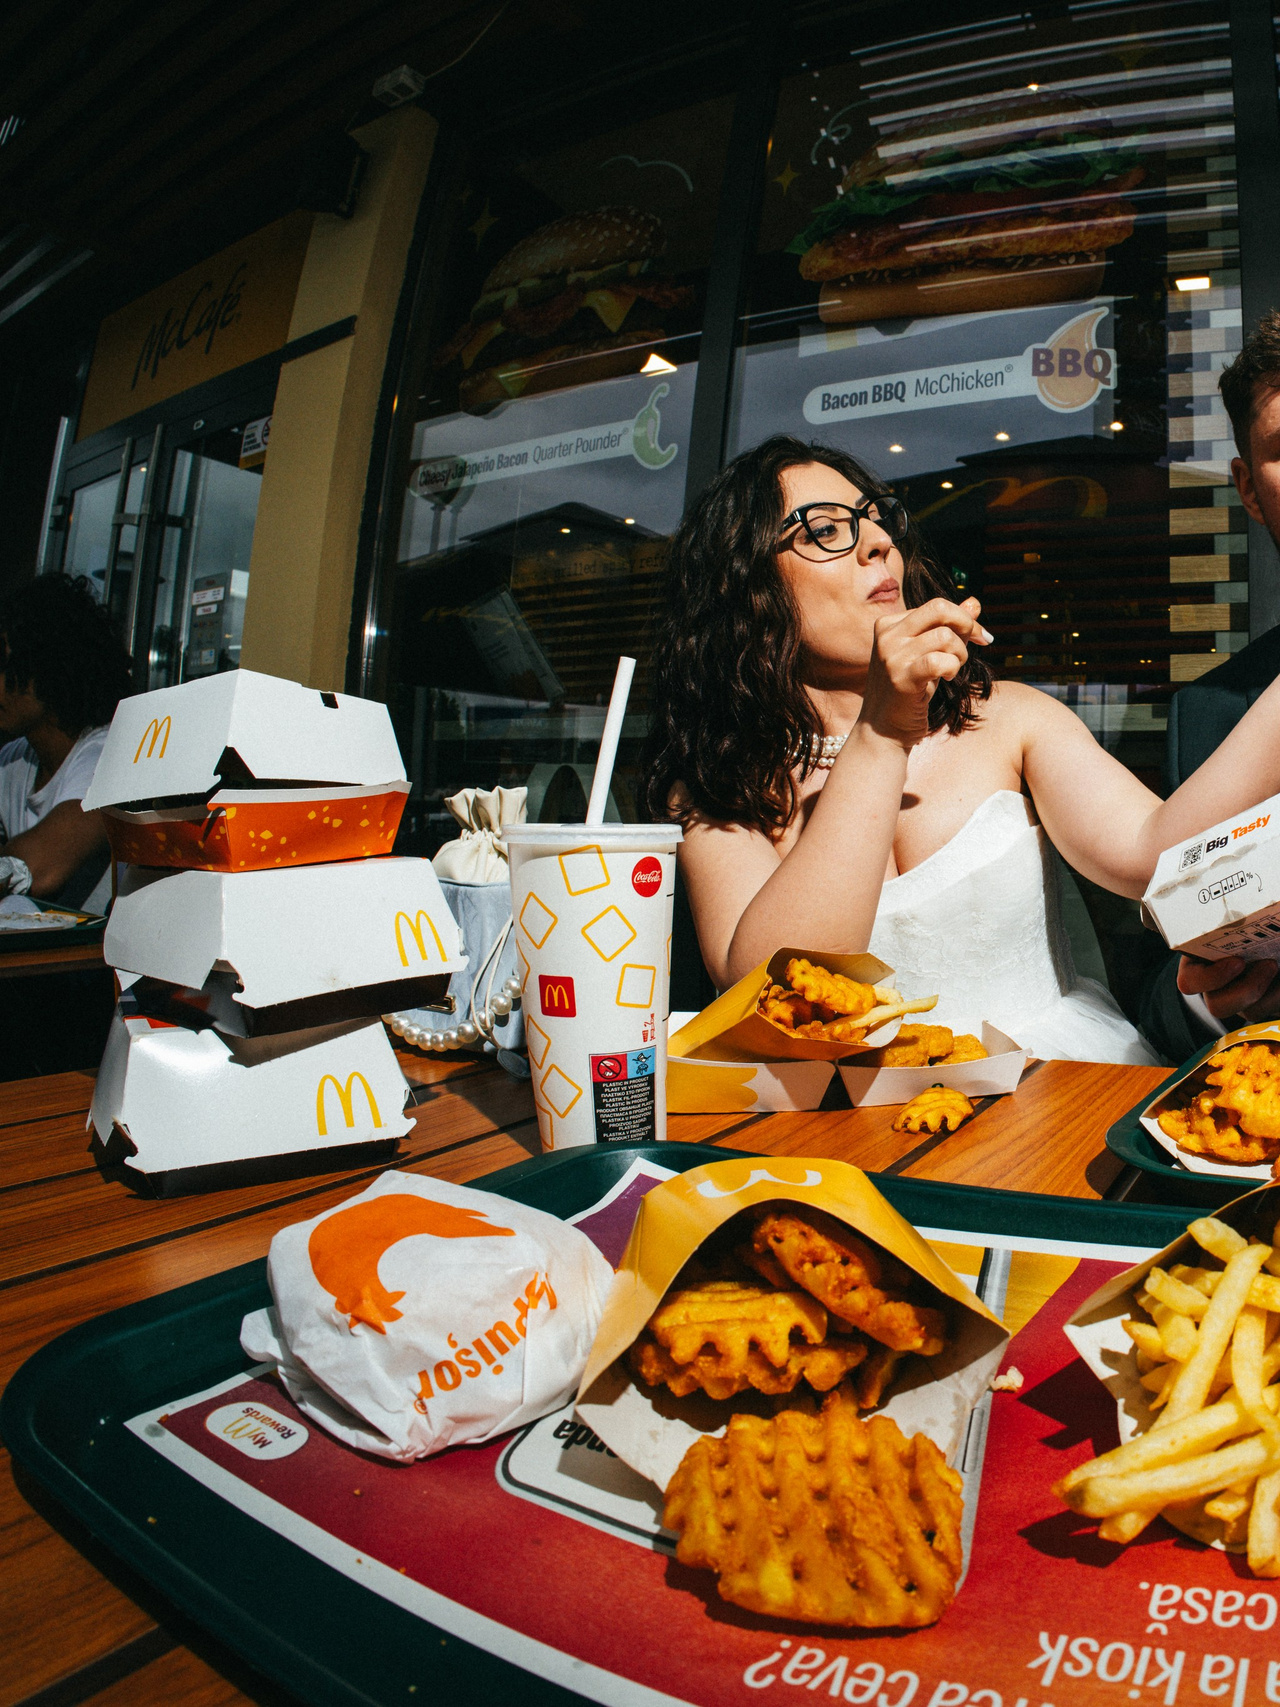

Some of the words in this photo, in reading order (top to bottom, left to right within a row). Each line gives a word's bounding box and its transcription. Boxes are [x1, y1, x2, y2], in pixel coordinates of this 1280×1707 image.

[131, 262, 248, 391] McCafé
[1031, 348, 1112, 386] BBQ
[821, 390, 868, 411] Bacon
[872, 381, 906, 403] BBQ
[419, 465, 452, 486] Cheesy
[452, 458, 495, 483] Jalapeño
[496, 450, 528, 470] Bacon
[533, 442, 572, 463] Quarter
[1206, 836, 1229, 853] Big
[1231, 814, 1271, 839] Tasty
[634, 870, 661, 883] Coca-Cola
[629, 1076, 649, 1084] PRODUCT
[242, 1407, 297, 1440] Rewards
[1139, 1581, 1279, 1636] casă.
[743, 1640, 920, 1707] ceva?
[1027, 1632, 1186, 1706] kiosk
[1199, 1654, 1251, 1707] la
